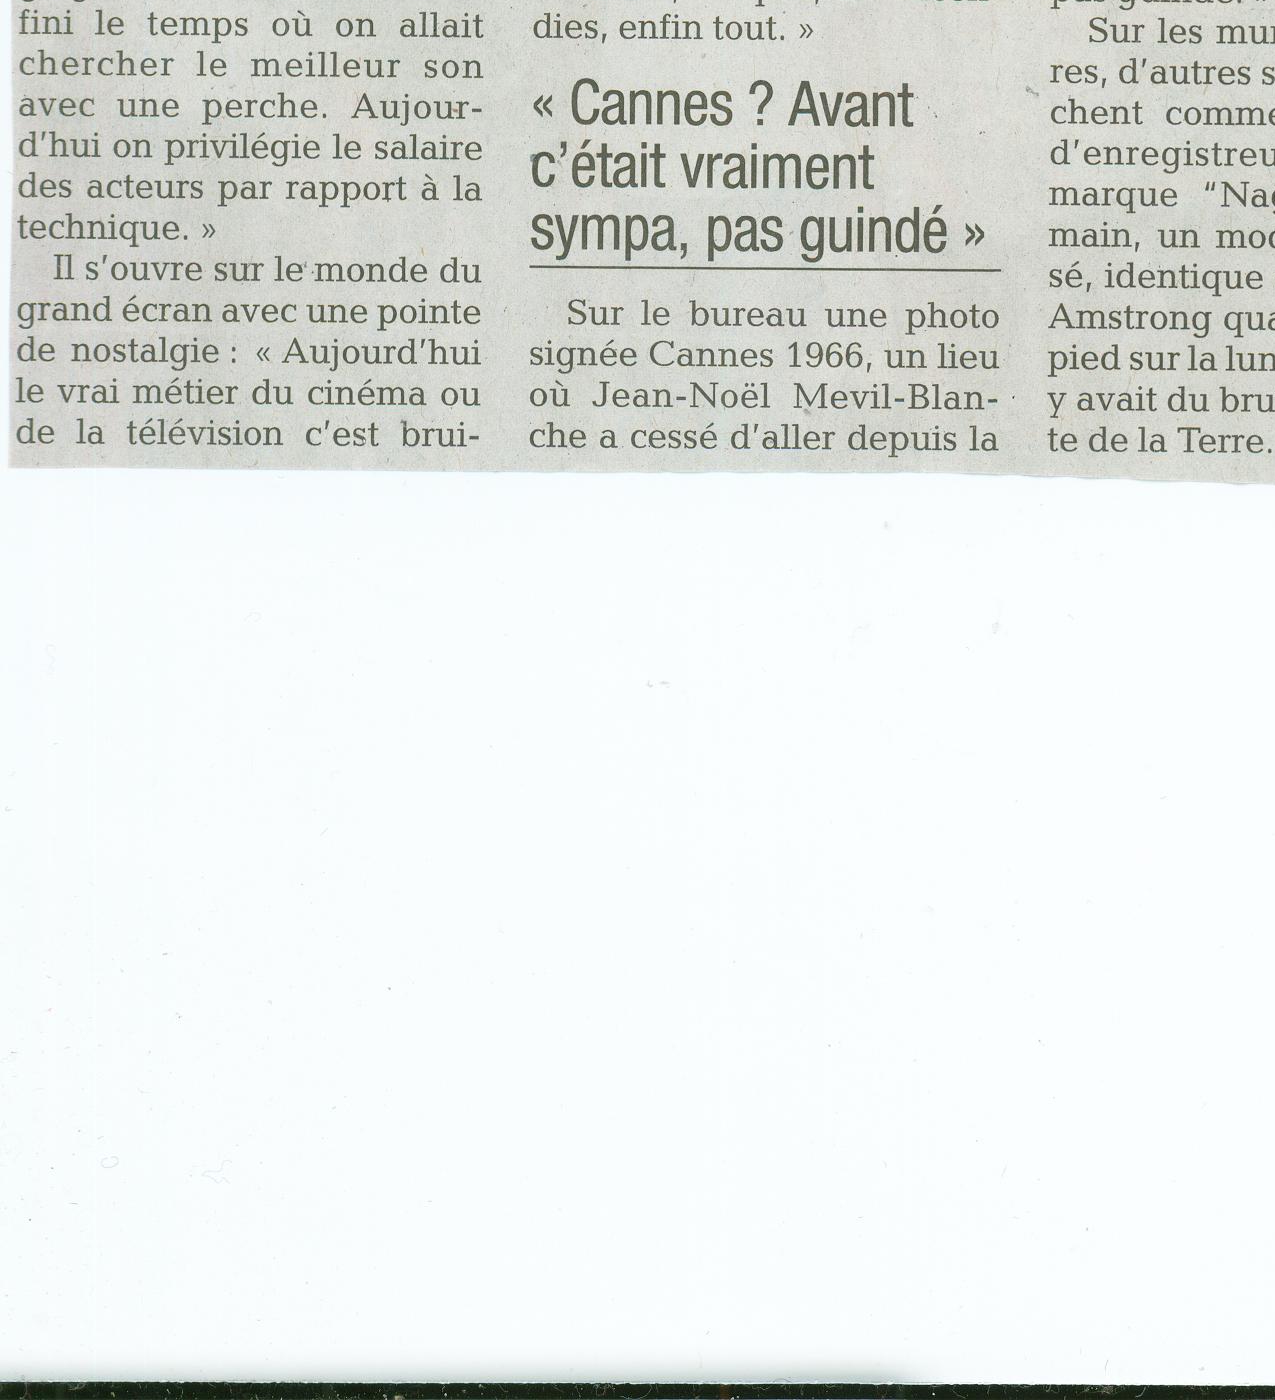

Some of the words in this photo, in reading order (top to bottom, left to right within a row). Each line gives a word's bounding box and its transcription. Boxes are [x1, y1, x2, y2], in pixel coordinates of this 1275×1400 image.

[19, 8, 73, 35] fini
[95, 9, 124, 36] le
[147, 12, 248, 44] temps
[272, 10, 312, 37] où
[335, 18, 377, 38] on
[399, 11, 484, 39] allait
[571, 77, 733, 127] Cannes
[788, 80, 914, 128] Avant
[1050, 98, 1143, 125] chent
[680, 144, 875, 190] vraiment
[530, 213, 688, 262] sympa,
[707, 215, 784, 262] pas
[800, 204, 948, 263] guindé
[1048, 228, 1140, 252] main,
[1157, 229, 1200, 249] un
[530, 346, 637, 375] signée
[649, 340, 774, 368] Cannes
[788, 341, 872, 373] 1966,
[884, 349, 927, 369] un
[937, 342, 1000, 370] lieu
[16, 376, 44, 403] le
[57, 378, 119, 404] vrai
[132, 380, 239, 405] métier
[251, 378, 293, 405] du
[307, 378, 427, 406] cinéma
[440, 387, 481, 407] ou
